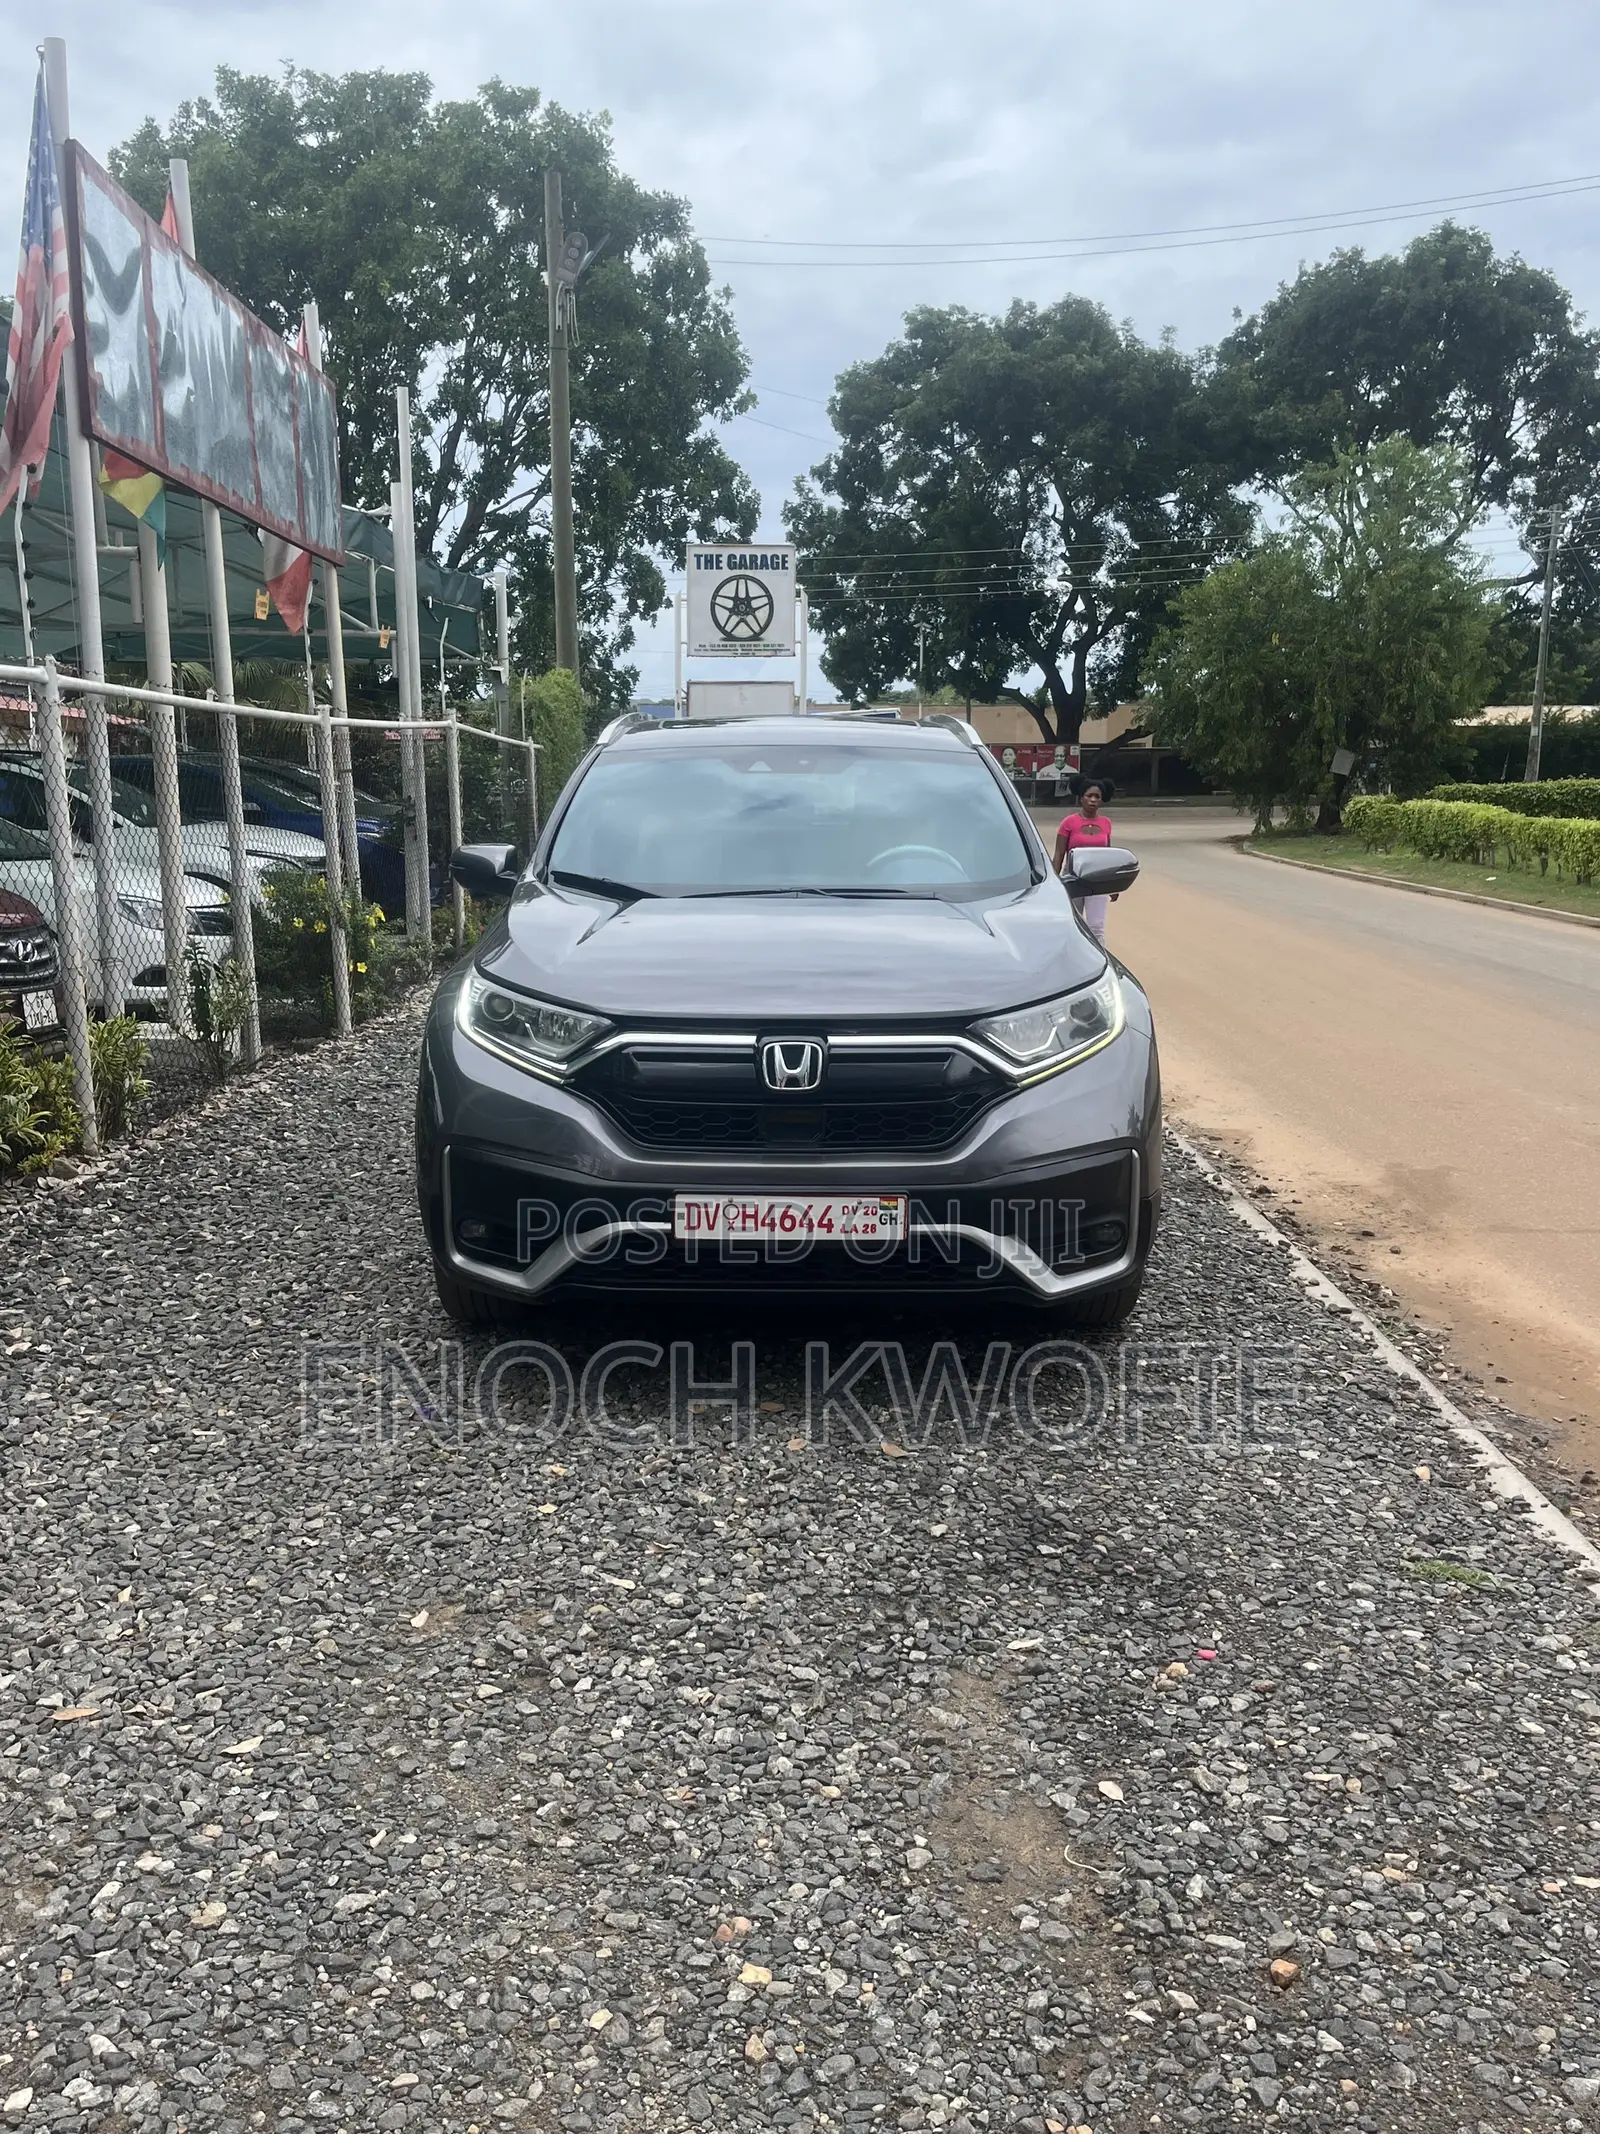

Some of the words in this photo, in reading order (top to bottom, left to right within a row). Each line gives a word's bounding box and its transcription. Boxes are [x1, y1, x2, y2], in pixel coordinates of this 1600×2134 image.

[694, 553, 723, 570] THE
[726, 553, 789, 571] GARAGE
[684, 1202, 720, 1231] DV
[741, 1203, 835, 1234] H4644
[841, 1205, 858, 1216] DV
[879, 1213, 898, 1226] GH
